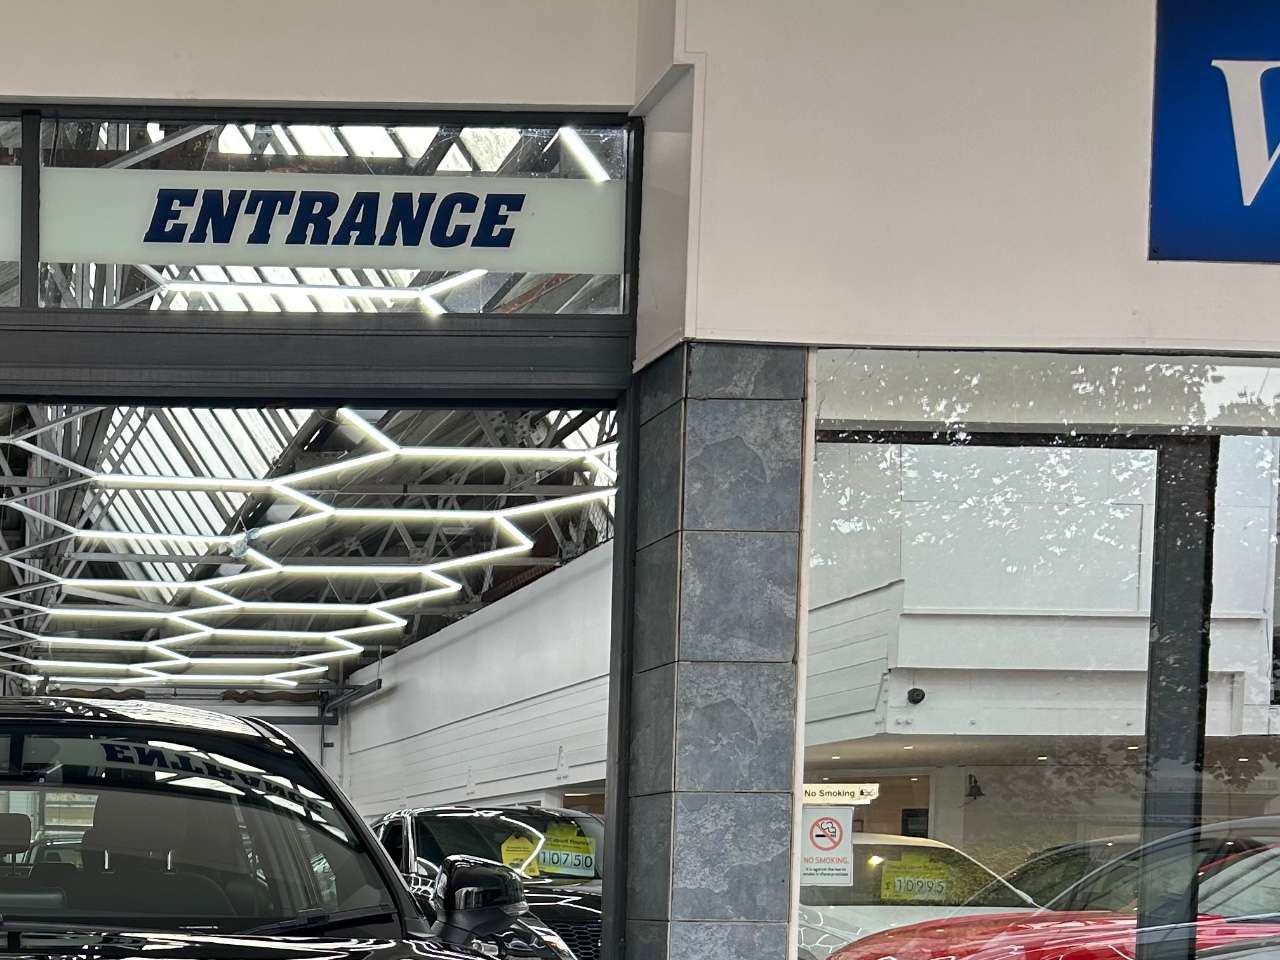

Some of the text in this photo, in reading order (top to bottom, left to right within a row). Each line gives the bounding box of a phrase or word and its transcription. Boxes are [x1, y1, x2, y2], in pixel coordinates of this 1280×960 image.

[143, 188, 526, 248] ENTRANCE
[804, 789, 855, 798] No Smoking
[540, 851, 594, 869] 10750
